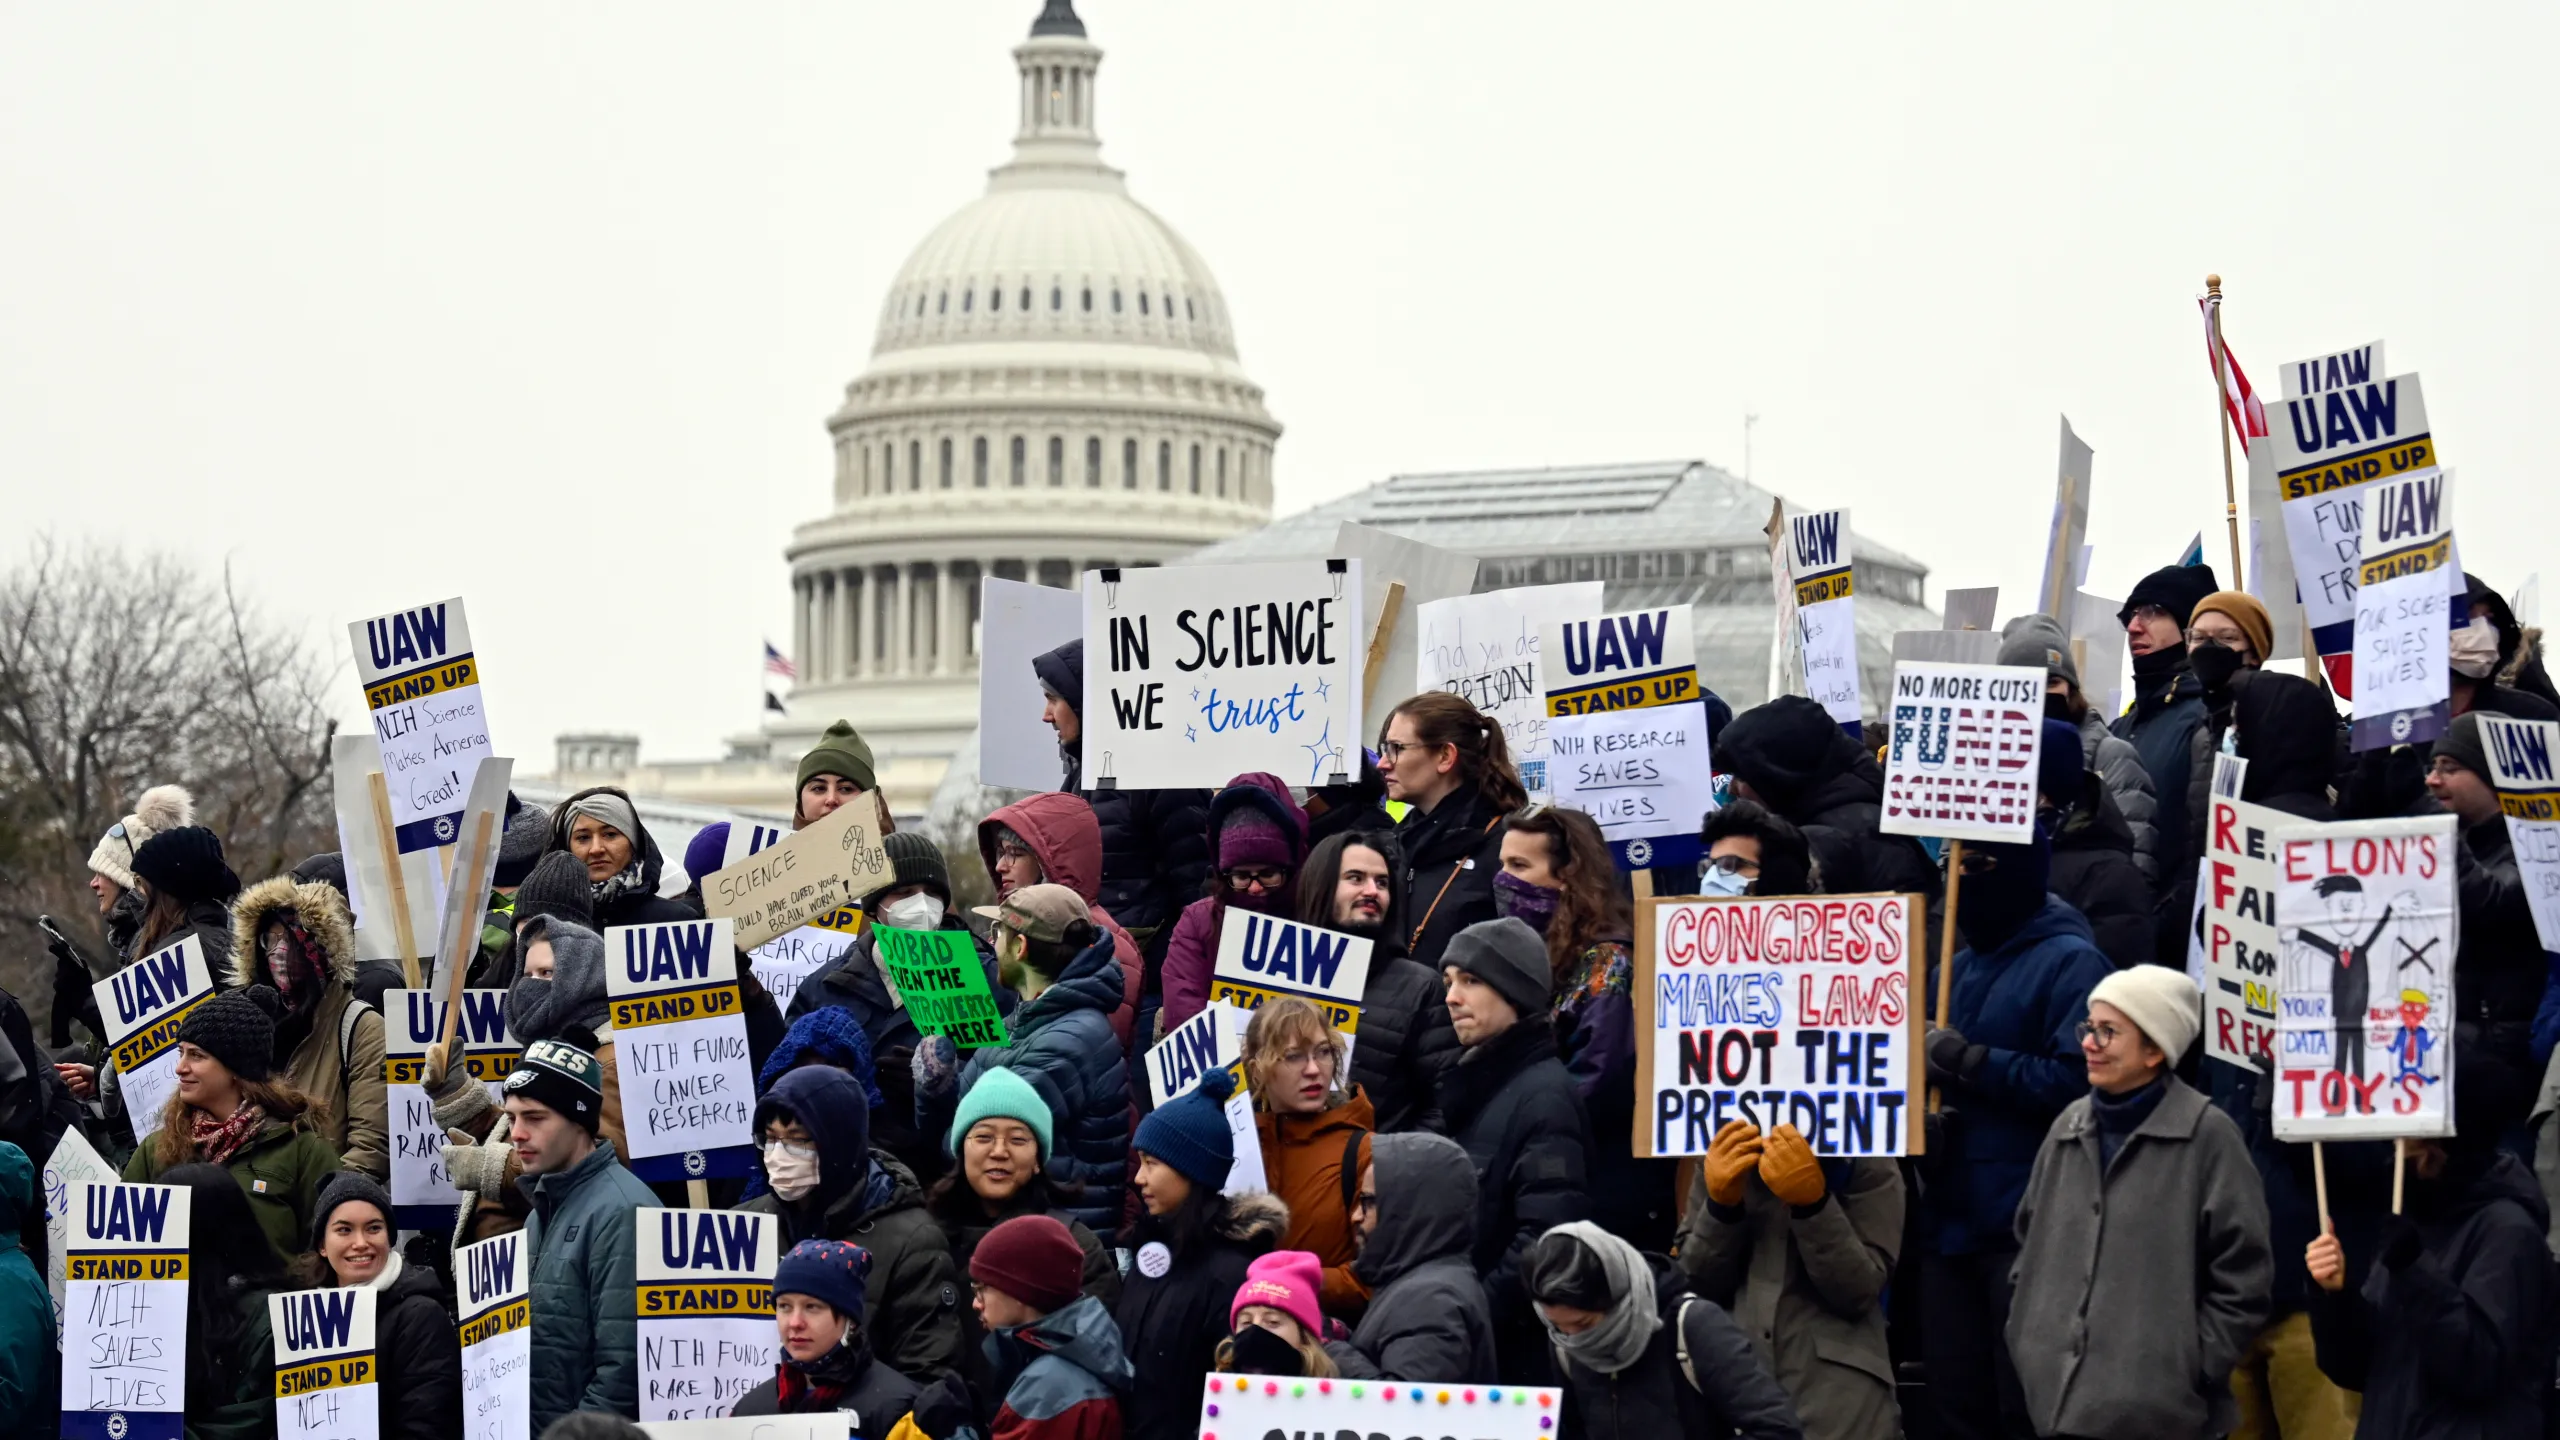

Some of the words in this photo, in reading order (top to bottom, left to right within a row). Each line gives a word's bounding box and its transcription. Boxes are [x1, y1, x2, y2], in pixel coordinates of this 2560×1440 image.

[2299, 345, 2372, 396] UAW
[2288, 379, 2397, 453] UAW
[2288, 458, 2381, 499] STAND
[2390, 446, 2427, 472] UP
[2378, 474, 2444, 543] UAW
[1794, 512, 1839, 567] UAW
[2364, 553, 2428, 586] STAND
[1797, 582, 1829, 606] STAND
[1833, 576, 1849, 597] UP
[367, 603, 446, 670] UAW
[1109, 614, 1150, 672] IN
[1175, 598, 1335, 672] SCIENCE
[1420, 617, 1468, 674] And
[1562, 610, 1668, 676] UAW
[2371, 627, 2428, 662] SAVES
[371, 678, 436, 709] STAND
[441, 664, 471, 688] UP
[1898, 675, 1924, 698] NO
[1930, 677, 1983, 700] MORE
[1989, 679, 2039, 703] CUTS!
[2368, 656, 2428, 692] LIVES
[1111, 683, 1164, 731] WE
[1201, 683, 1305, 733] trust
[1554, 686, 1645, 717] STAND
[1653, 676, 1691, 701] UP
[376, 705, 418, 744] NIH
[422, 700, 476, 728] Science
[1552, 735, 1584, 756] NIH
[1594, 730, 1686, 755] RESEARCH
[1891, 705, 2034, 774] FUND
[384, 750, 426, 777] Makes
[433, 733, 488, 760] America
[1578, 759, 1660, 784] SAVES
[2486, 721, 2554, 780] UAW
[410, 770, 461, 811] Great!
[1583, 797, 1655, 818] LIVES
[1888, 774, 2030, 825] SCIENCE!
[2504, 798, 2552, 818] STAND
[719, 850, 797, 906] SCIENCE
[2285, 835, 2438, 882] ELON'S
[766, 894, 788, 917] HAVE
[790, 885, 815, 904] CURED
[818, 874, 840, 893] YOUR
[768, 906, 805, 932] BRAIN
[1665, 901, 1902, 967] CONGRESS
[625, 923, 713, 983] UAW
[1242, 915, 1349, 990] UAW
[112, 944, 189, 1025] UAW
[889, 964, 926, 991] EVEN
[923, 967, 965, 991] THE
[617, 996, 695, 1025] STAND
[702, 991, 733, 1012] UP
[1658, 972, 1783, 1029] MAKES
[1798, 971, 1908, 1028] LAWS
[2281, 996, 2326, 1018] YOUR
[943, 1019, 1000, 1045] HERE
[1158, 1008, 1219, 1098] UAW
[2285, 1031, 2329, 1055] DATA
[394, 1058, 485, 1082] STD
[631, 1043, 678, 1077] NIH
[693, 1036, 746, 1065] FUNDS
[1678, 1028, 1779, 1087] NOT
[1795, 1029, 1890, 1087] THE
[126, 1069, 161, 1104] THE
[654, 1073, 730, 1106] CANCER
[2282, 1069, 2424, 1118] TOYS
[648, 1101, 748, 1136] RESEARCH
[86, 1184, 171, 1243] UAW
[661, 1212, 761, 1272] UAW
[72, 1259, 143, 1280] STAND
[151, 1259, 182, 1279] UP
[467, 1235, 517, 1304] UAW
[88, 1282, 152, 1329] NIH
[282, 1291, 356, 1351] UAW
[645, 1289, 738, 1311] STAND
[464, 1317, 500, 1347] STAND
[506, 1305, 526, 1327] UP
[90, 1333, 164, 1367] SAVES
[489, 1353, 527, 1379] Research
[645, 1336, 704, 1372] NIH
[718, 1340, 769, 1368] FUNDS
[89, 1374, 166, 1410] LIVES
[280, 1366, 332, 1395] STAND
[339, 1361, 369, 1384] UP
[649, 1378, 702, 1401] RARE
[298, 1393, 341, 1432] NIH
